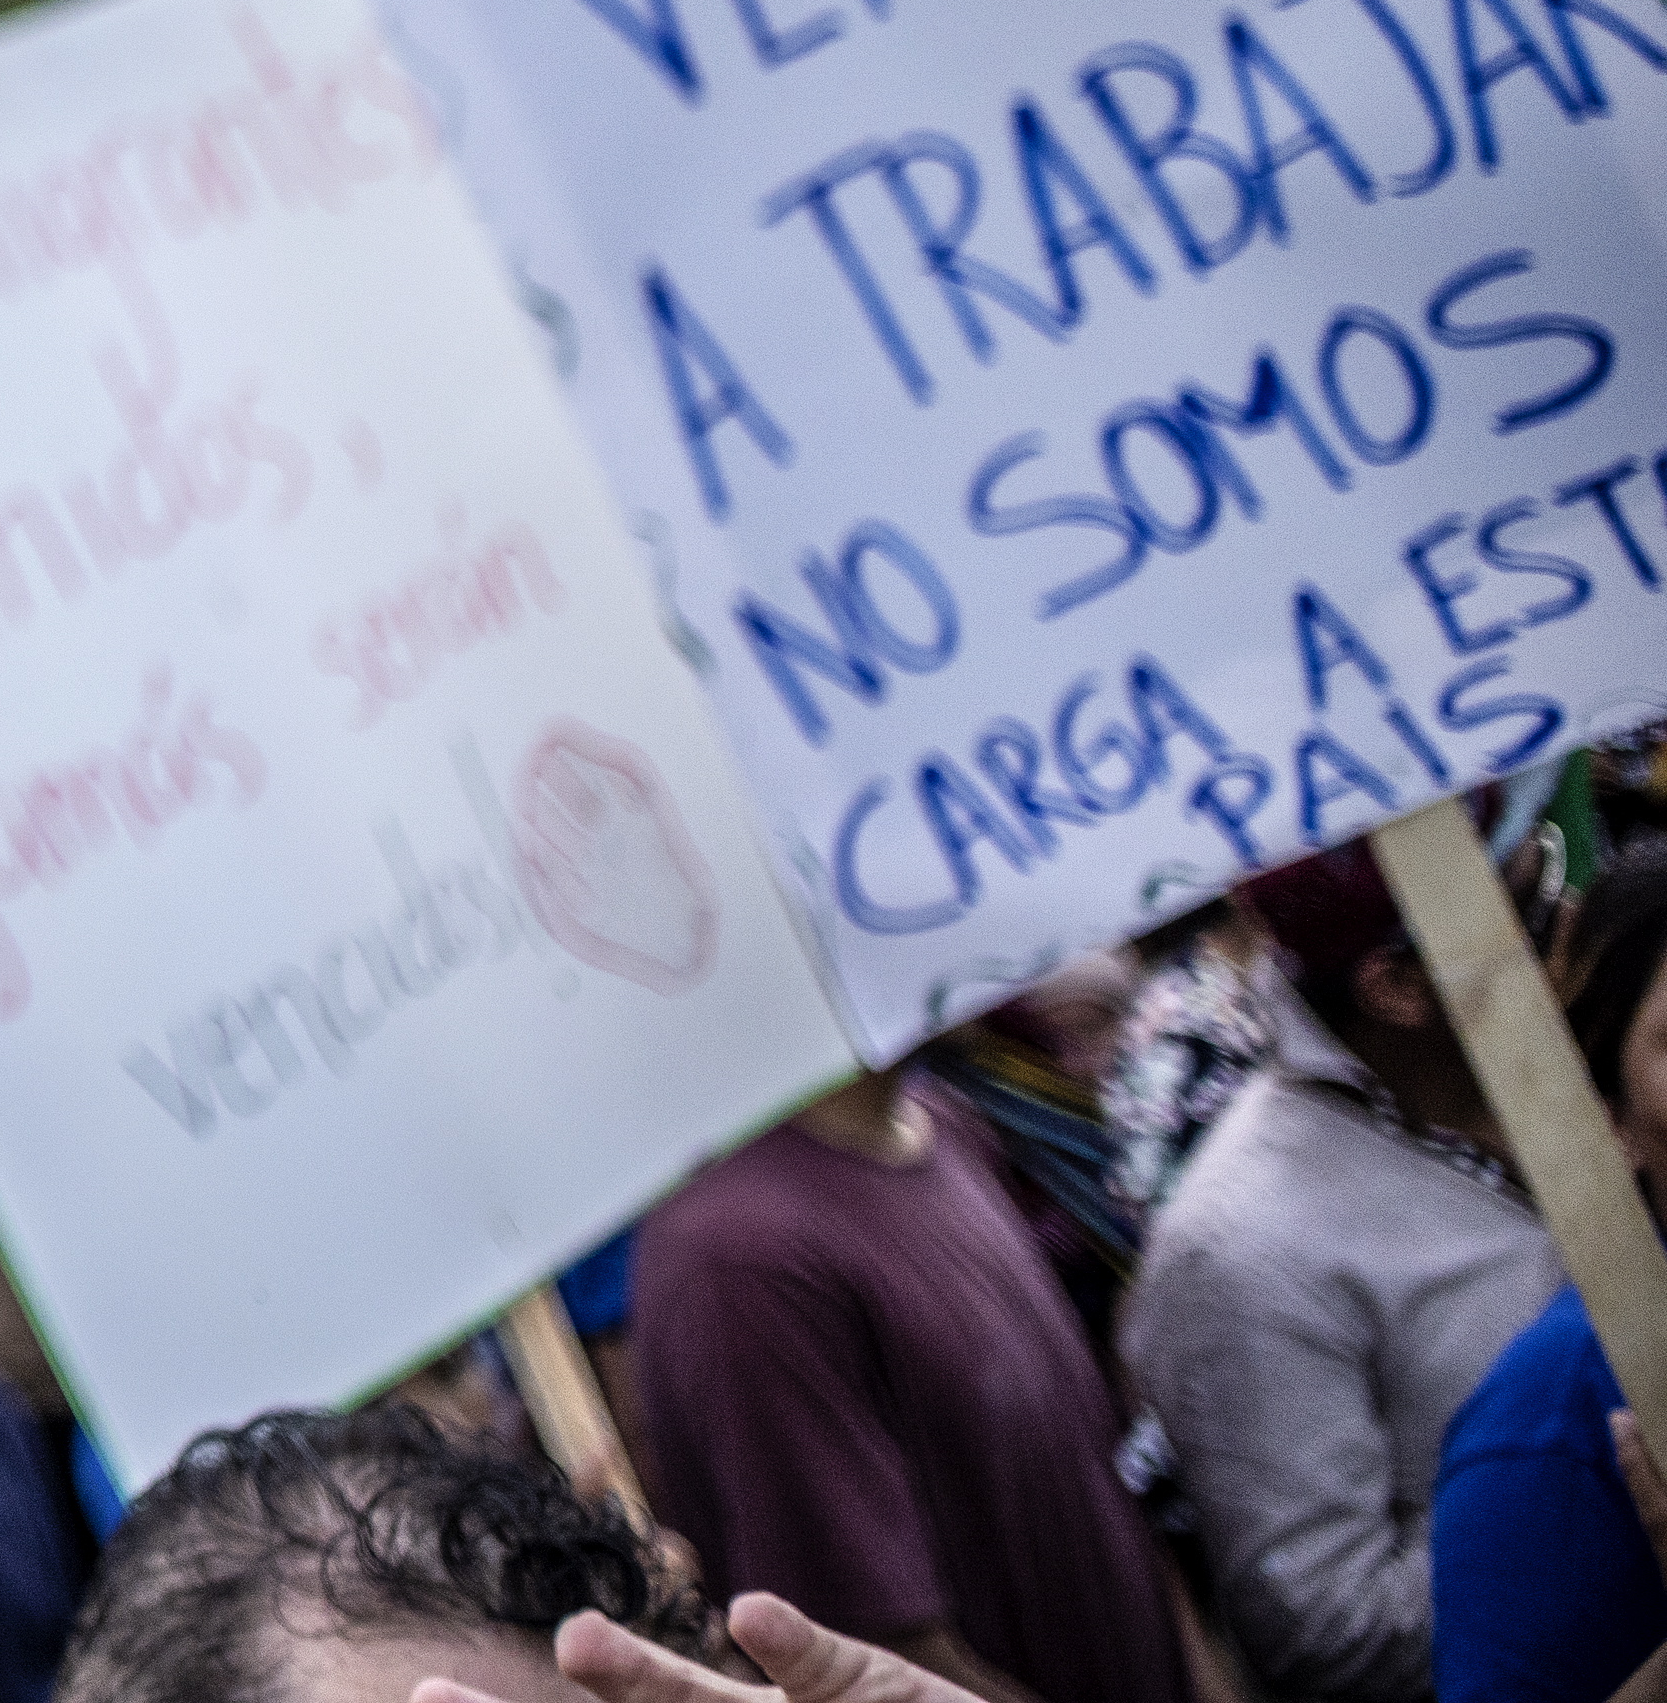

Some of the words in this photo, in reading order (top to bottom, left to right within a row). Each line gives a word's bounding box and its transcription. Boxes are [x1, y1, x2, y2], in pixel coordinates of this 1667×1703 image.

[639, 257, 795, 525] A
[733, 517, 963, 749] NO
[967, 247, 1615, 621] SOMOS
[832, 651, 1229, 937] CARGA
[1293, 580, 1393, 712] A
[1401, 445, 1667, 659] EST
[1187, 652, 1563, 871] PAIS
